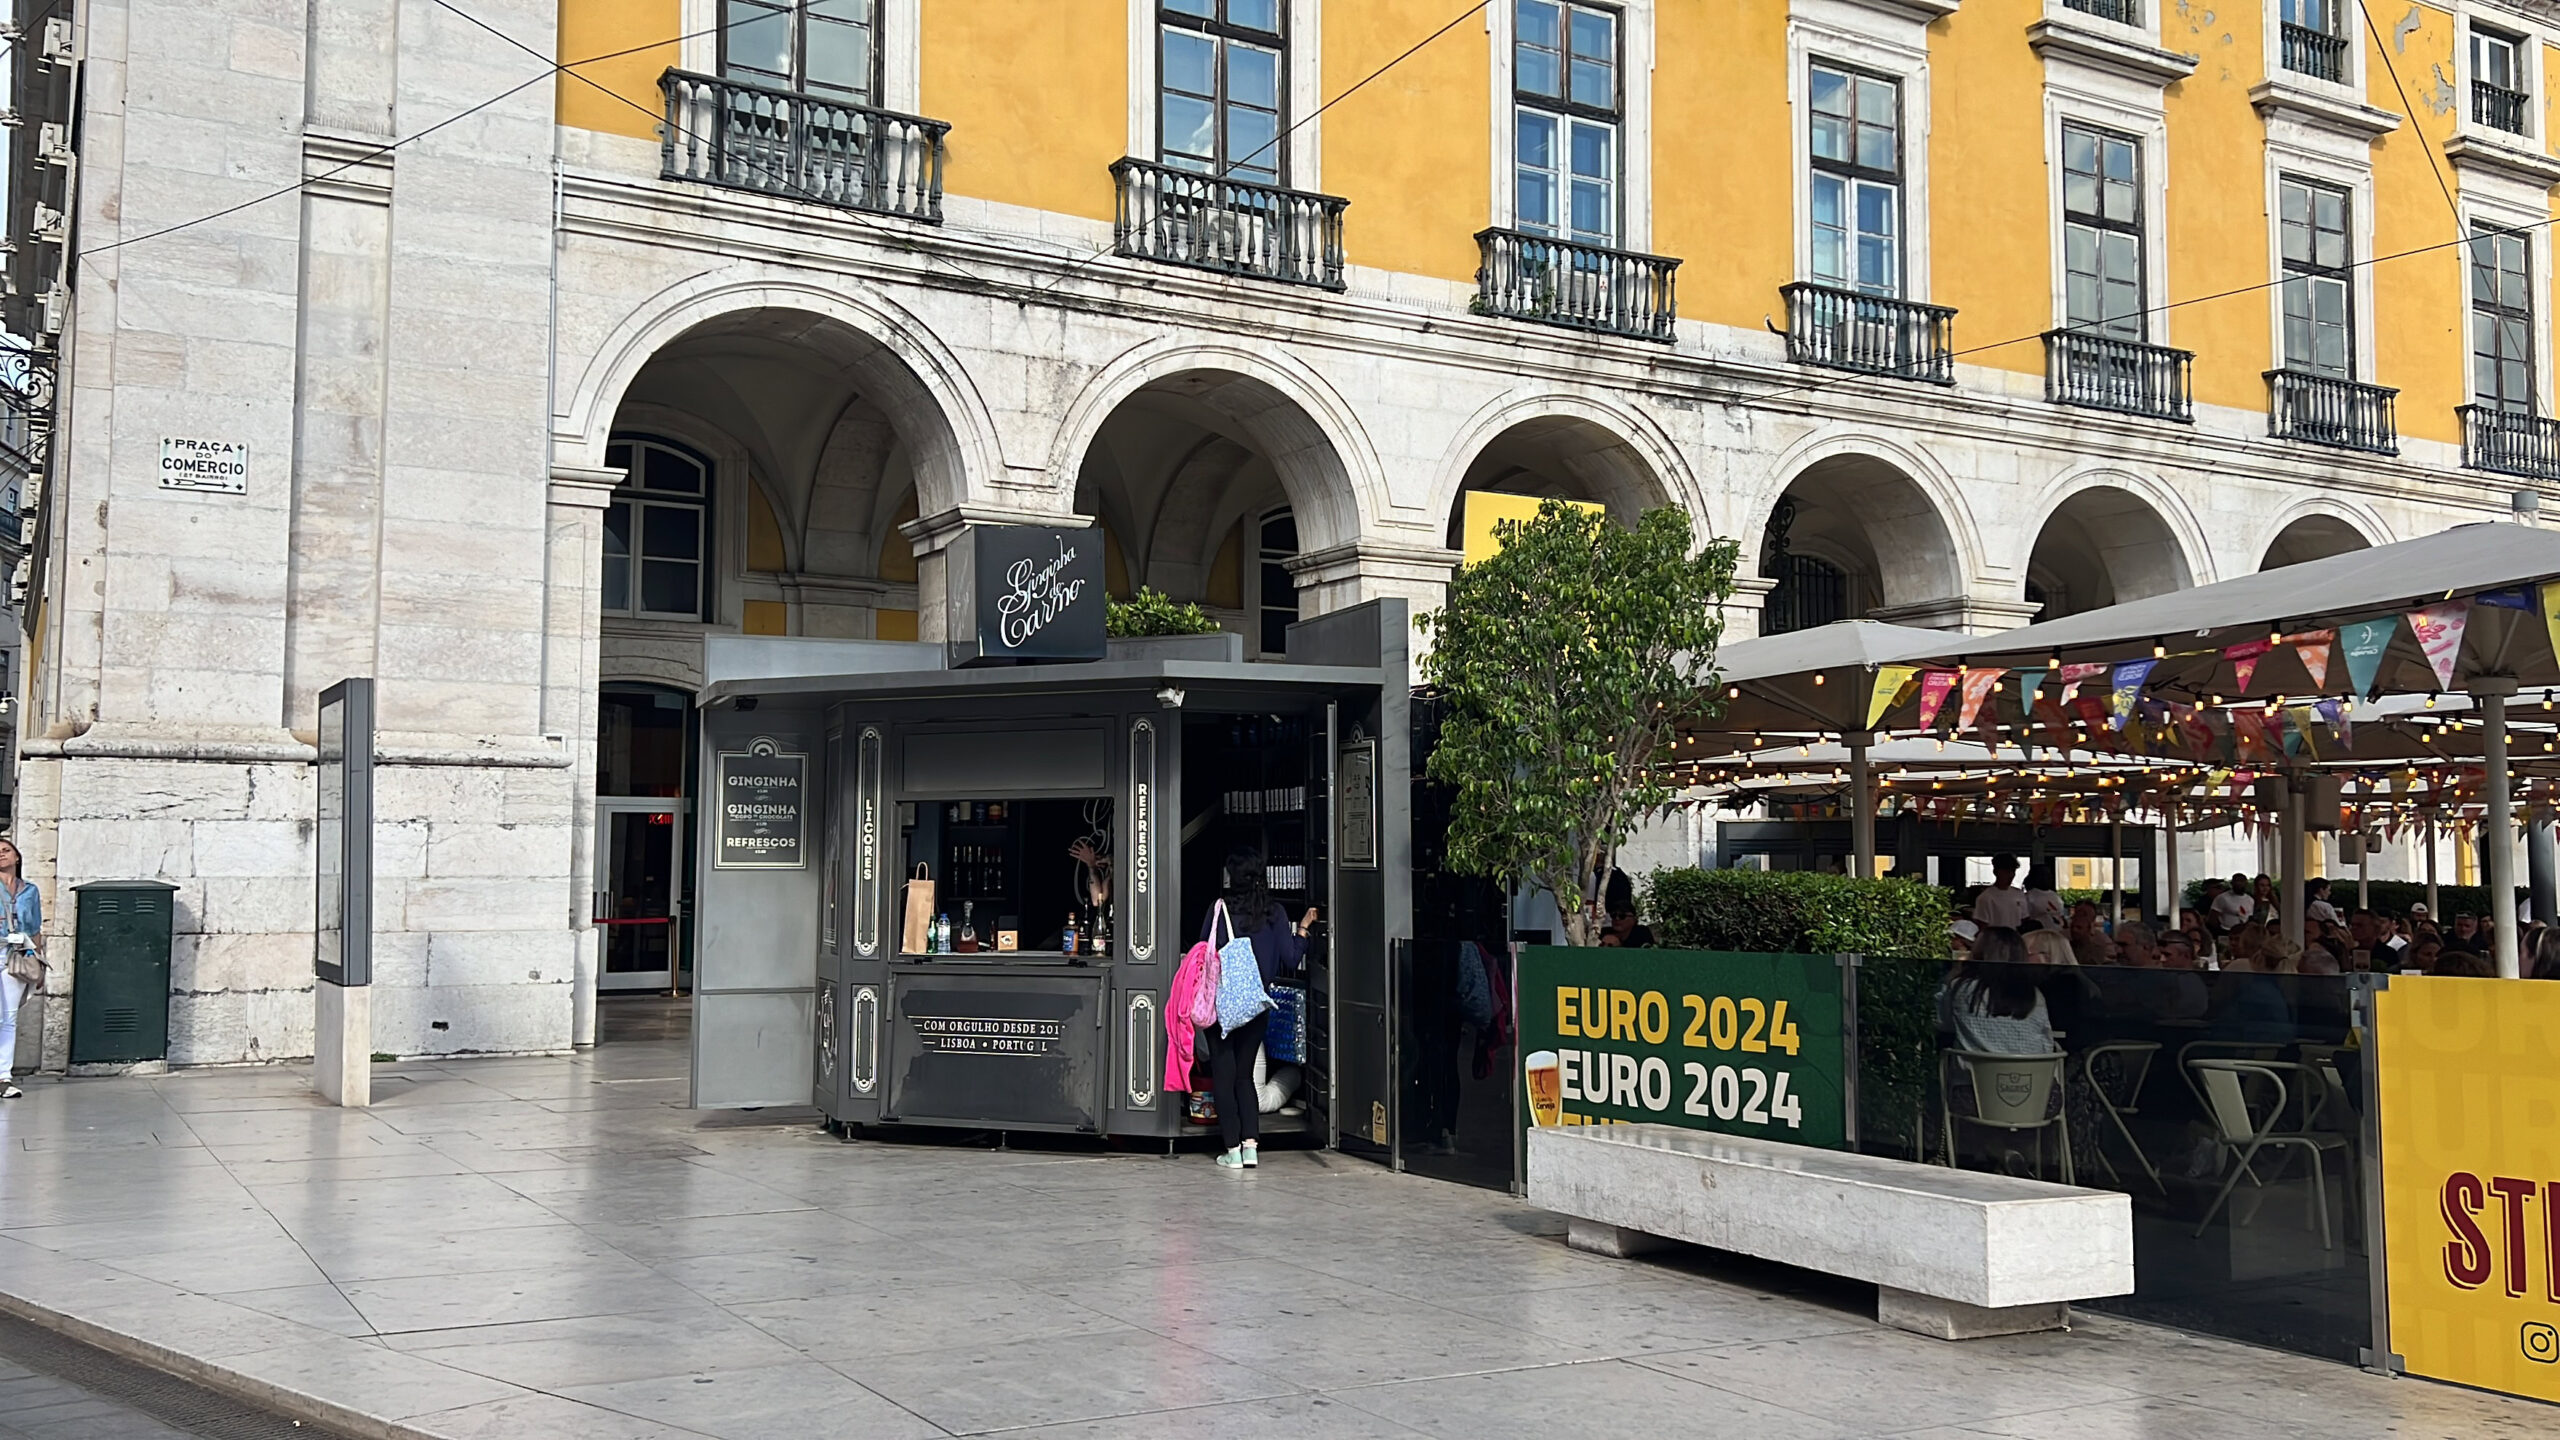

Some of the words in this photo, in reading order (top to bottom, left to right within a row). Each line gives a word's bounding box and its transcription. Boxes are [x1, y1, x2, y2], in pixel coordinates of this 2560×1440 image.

[175, 439, 233, 455] PRAÇA
[162, 458, 244, 475] COMERCIO
[1007, 534, 1077, 613] Ginginha
[997, 579, 1086, 648] Carmo
[728, 776, 798, 787] GINGINHA
[727, 804, 797, 815] GINGINHA
[726, 838, 796, 847] REFRESCOS
[863, 799, 874, 880] LICORES
[1137, 783, 1148, 893] REFRESCOS
[924, 1020, 946, 1031] COM
[949, 1022, 1000, 1033] ORGULHO
[1003, 1023, 1036, 1034] DESDE
[1040, 1024, 1066, 1035] 201
[1557, 986, 1669, 1044] EURO
[1682, 994, 1800, 1056] 2024
[940, 1037, 976, 1049] LISBOA
[1558, 1048, 1671, 1112] EURO
[1683, 1062, 1802, 1128] 2024
[1536, 1102, 1556, 1111] Cerveja
